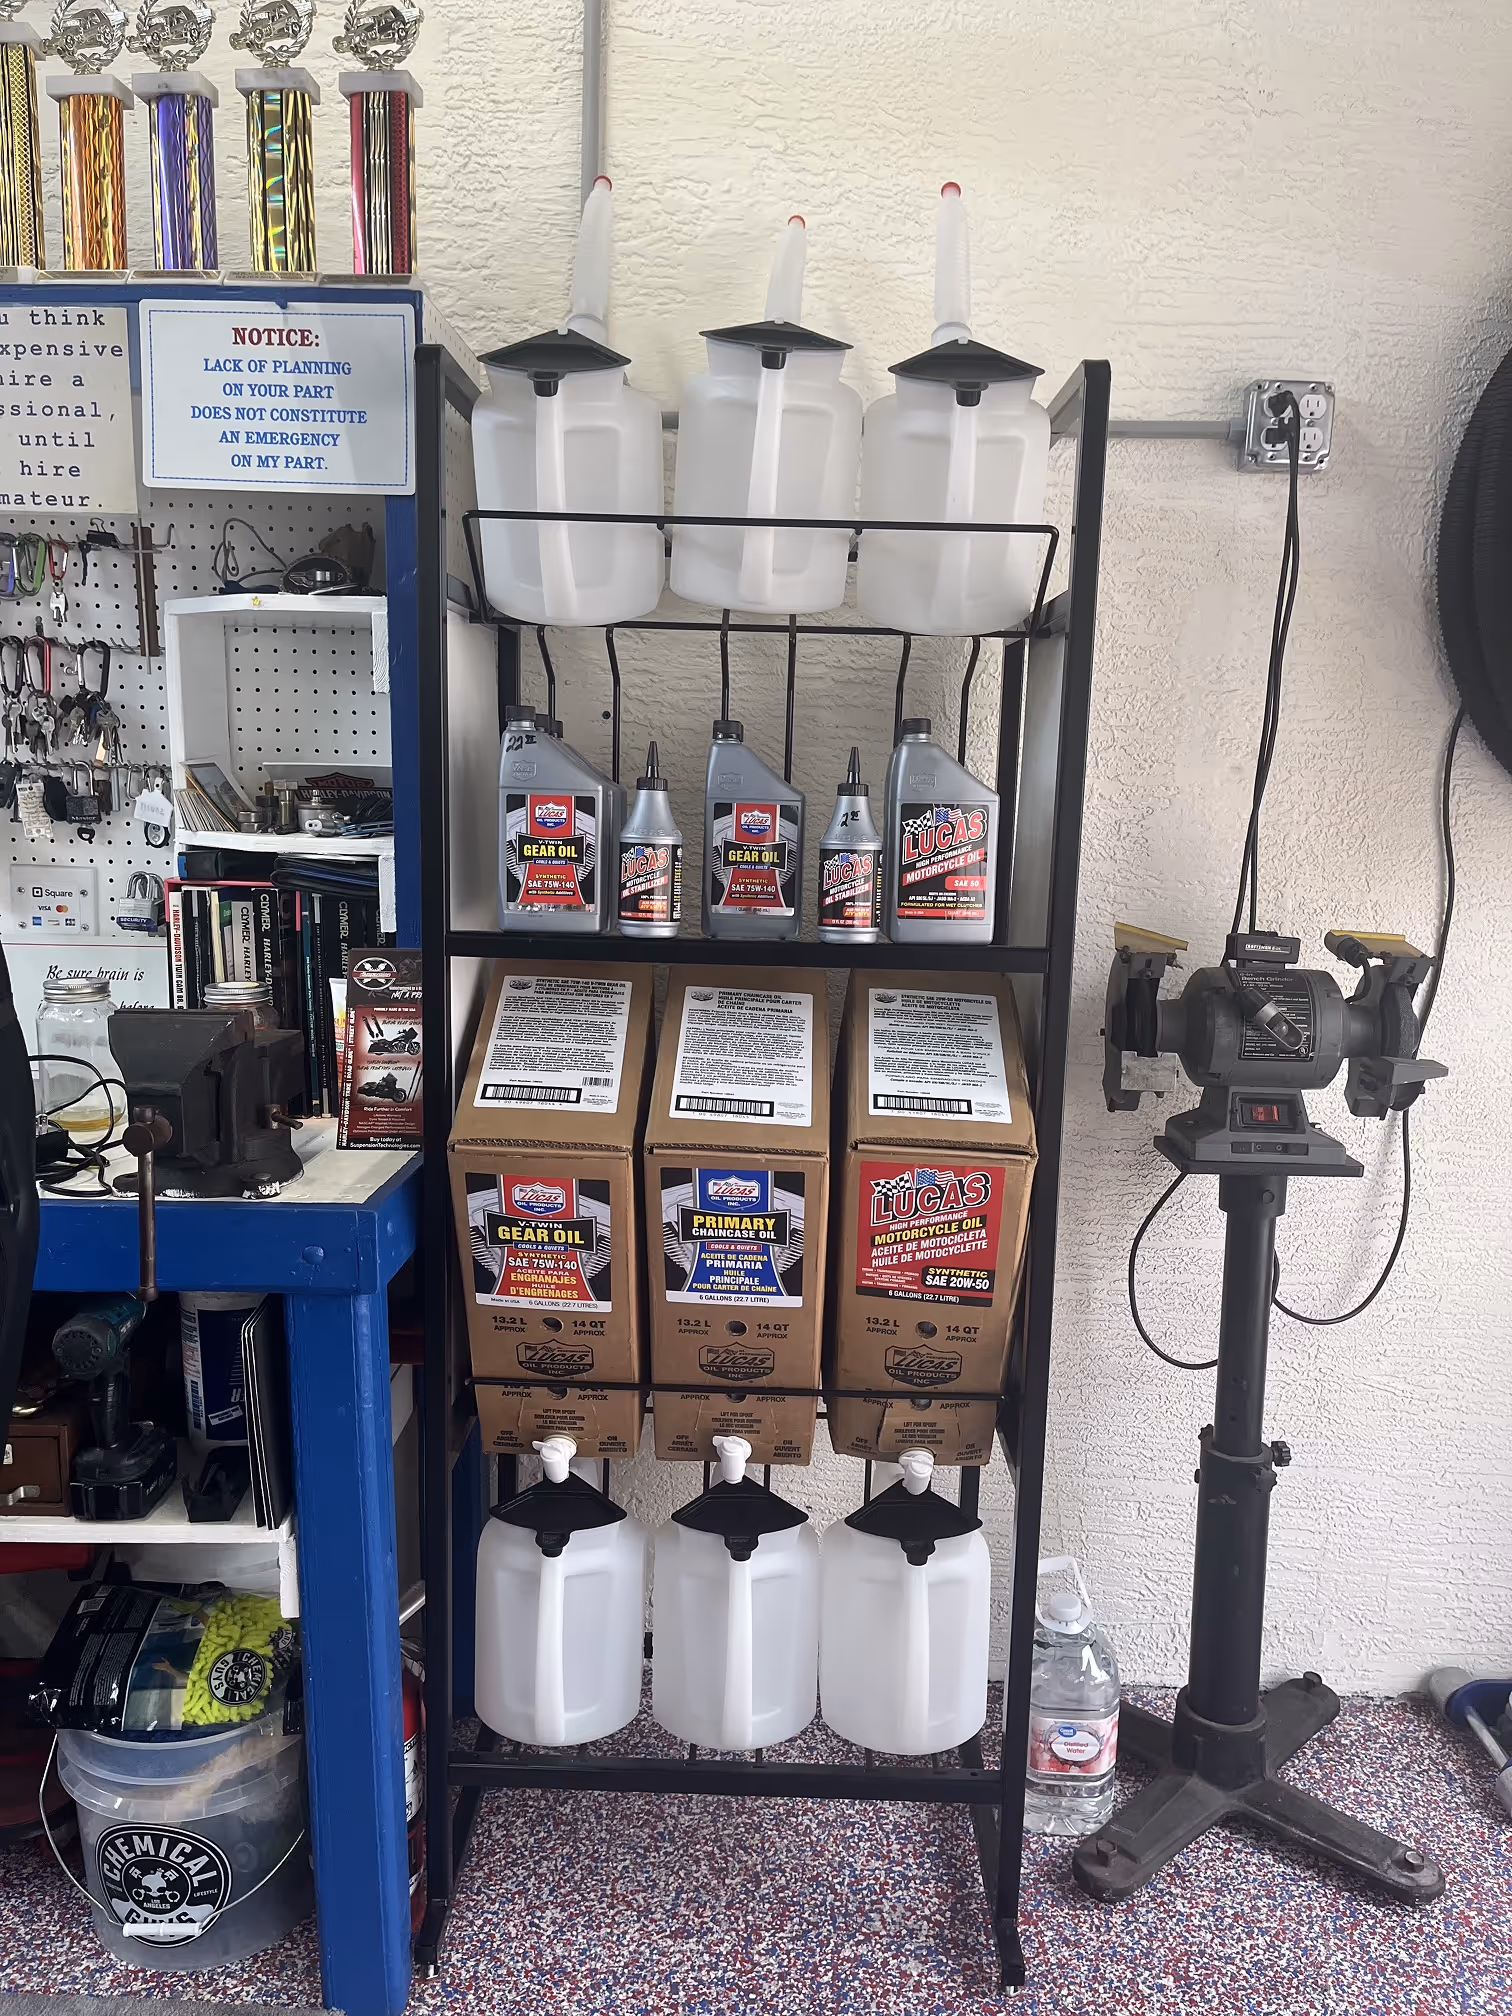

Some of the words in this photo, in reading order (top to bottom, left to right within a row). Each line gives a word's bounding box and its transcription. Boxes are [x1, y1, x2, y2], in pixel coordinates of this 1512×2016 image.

[30, 309, 105, 325] think
[232, 327, 320, 347] NOTICE:
[0, 340, 123, 360] xpensive
[203, 358, 244, 372] LACK
[247, 360, 268, 373] OF
[272, 360, 352, 376] PLANNING
[72, 375, 84, 387] a
[222, 383, 244, 397] ON
[247, 383, 289, 398] YOUR
[293, 385, 335, 399] PART
[190, 405, 232, 420] DOES
[235, 407, 267, 421] NOT
[270, 408, 368, 424] CONSTITUTE
[19, 432, 95, 447] until
[219, 430, 241, 444] AN
[244, 431, 340, 447] EMERGENCY
[20, 460, 81, 477] hire
[231, 454, 252, 468] ON
[256, 455, 281, 468] MY
[284, 456, 328, 470] PART.
[904, 811, 986, 864] LUCAS
[523, 845, 556, 857] GEAR
[558, 845, 578, 857] OIL
[728, 850, 759, 862] GEAR
[761, 851, 780, 863] OIL
[915, 859, 930, 869] HIGH
[930, 844, 972, 864] PERFORMANCE
[621, 848, 669, 882] LUCAS
[824, 855, 873, 889] LUCAS
[906, 856, 965, 884] MOTORCYCLE
[967, 852, 980, 863] OIL
[528, 880, 542, 888] SAE
[544, 881, 575, 889] 75W-140
[622, 888, 630, 898] OIL
[631, 877, 665, 894] STABILIZER
[954, 879, 969, 887] SAE
[45, 889, 73, 897] Square
[260, 893, 271, 932] CLYMER
[339, 901, 349, 939] CLYMER
[240, 906, 251, 944] CLYMER
[172, 909, 182, 962] HARLEY-DAVIDSON
[47, 965, 62, 979] Be
[67, 969, 93, 977] sure
[97, 967, 129, 980] brain
[134, 968, 145, 981] is
[175, 963, 183, 978] TWIN
[521, 1192, 561, 1202] LUCAS
[713, 1186, 755, 1196] LUCAS
[872, 1173, 991, 1225] LUCAS
[518, 1221, 563, 1229] V-TWIN
[693, 1215, 776, 1231] PRIMARY
[889, 1222, 908, 1231] HIGH
[910, 1210, 968, 1228] PERFORMANCE
[497, 1226, 549, 1243] GEAR
[553, 1229, 585, 1244] OIL
[692, 1227, 756, 1238] CHAINCASE
[759, 1230, 777, 1239] OIL
[874, 1221, 959, 1245] MOTORCYCLE
[962, 1218, 983, 1230] OIL
[871, 1243, 904, 1258] ACEITE
[906, 1241, 918, 1251] DE
[920, 1229, 987, 1249] MOTOCICLETA
[517, 1252, 567, 1260] SYNTHETIC
[701, 1252, 726, 1260] ACEITE
[738, 1254, 768, 1262] CADENA
[872, 1253, 899, 1267] HUILE
[901, 1251, 913, 1263] DE
[915, 1239, 988, 1261] MOTOCYCLETTE
[508, 1258, 529, 1268] SAE
[532, 1259, 577, 1270] 75W-140
[706, 1260, 763, 1270] PRIMARIA
[510, 1273, 577, 1285] ENGRANAJES
[928, 1267, 988, 1278] SYNTHETIC
[709, 1276, 760, 1285] PRINCIPALE
[925, 1275, 948, 1287] SAE
[950, 1276, 990, 1290] 20W-50
[509, 1286, 578, 1299] D'ENGRENAGES
[894, 1290, 922, 1299] GALLONS
[923, 1292, 939, 1301] (22.7
[939, 1294, 960, 1303] LITRE)
[492, 1316, 518, 1325] 13.2
[571, 1320, 586, 1328] 14
[589, 1321, 606, 1329] QT
[866, 1316, 890, 1326] 13.2
[893, 1319, 900, 1327] L
[494, 1325, 526, 1333] APPROX
[866, 1327, 898, 1336] APPROX
[946, 1325, 960, 1333] 14
[962, 1326, 980, 1335] QT
[945, 1335, 977, 1343] APPROX
[709, 1355, 770, 1366] LUCAS
[501, 1390, 532, 1398] APPROX
[213, 1659, 230, 1691] GUYS
[234, 1652, 262, 1701] CHEMICAL
[103, 1835, 217, 1887] CHEMICAL
[193, 1888, 218, 1898] LIFESTYLE
